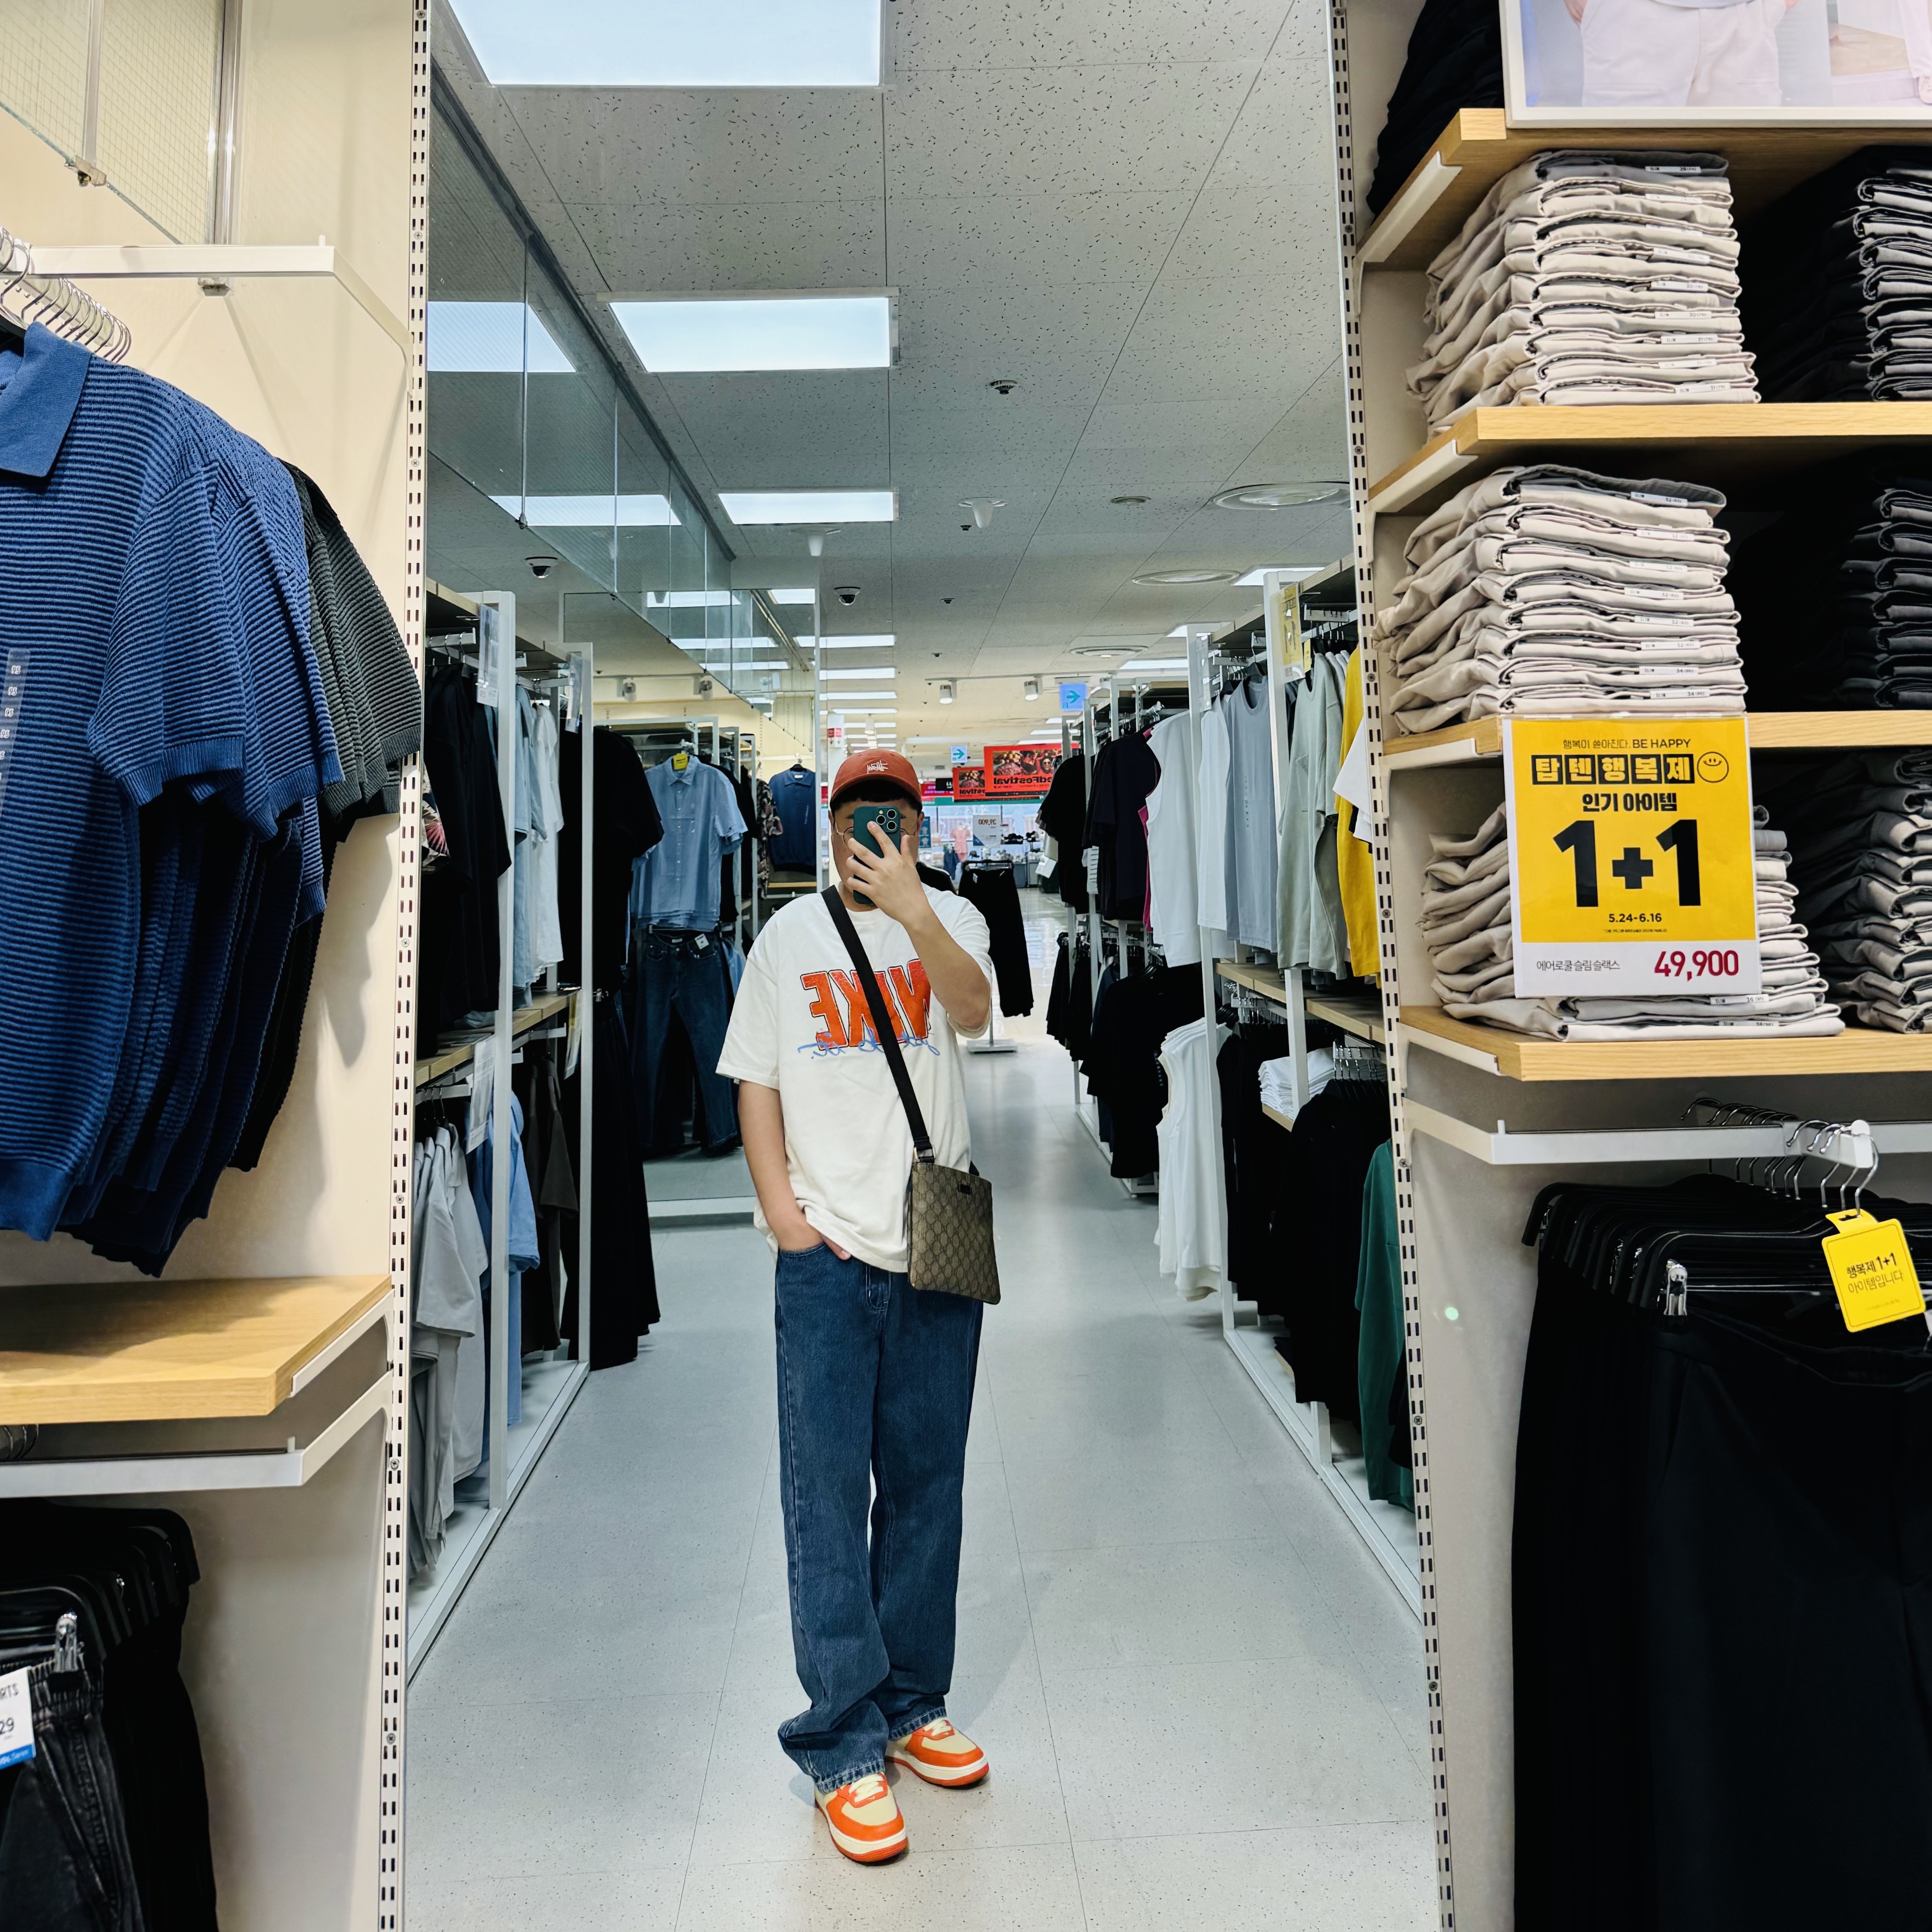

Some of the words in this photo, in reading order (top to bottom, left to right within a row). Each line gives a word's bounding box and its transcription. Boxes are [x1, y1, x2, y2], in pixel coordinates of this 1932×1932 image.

[11, 665, 21, 674] 95
[8, 686, 17, 696] 95
[5, 708, 14, 717] 95
[0, 729, 10, 738] 95
[1563, 739, 1590, 749] 행복이
[1632, 739, 1648, 748] BE
[1651, 738, 1691, 748] HAPPY
[1582, 793, 1618, 812] 인기
[1623, 793, 1677, 811] 아이템
[1553, 819, 1701, 907] 1+1
[1609, 913, 1662, 922] 5.24-6.16
[1654, 950, 1739, 982] 49,900
[1846, 1260, 1876, 1279] 행복제
[1876, 1252, 1897, 1270] 1+1
[1848, 1270, 1904, 1294] 아이템입니다
